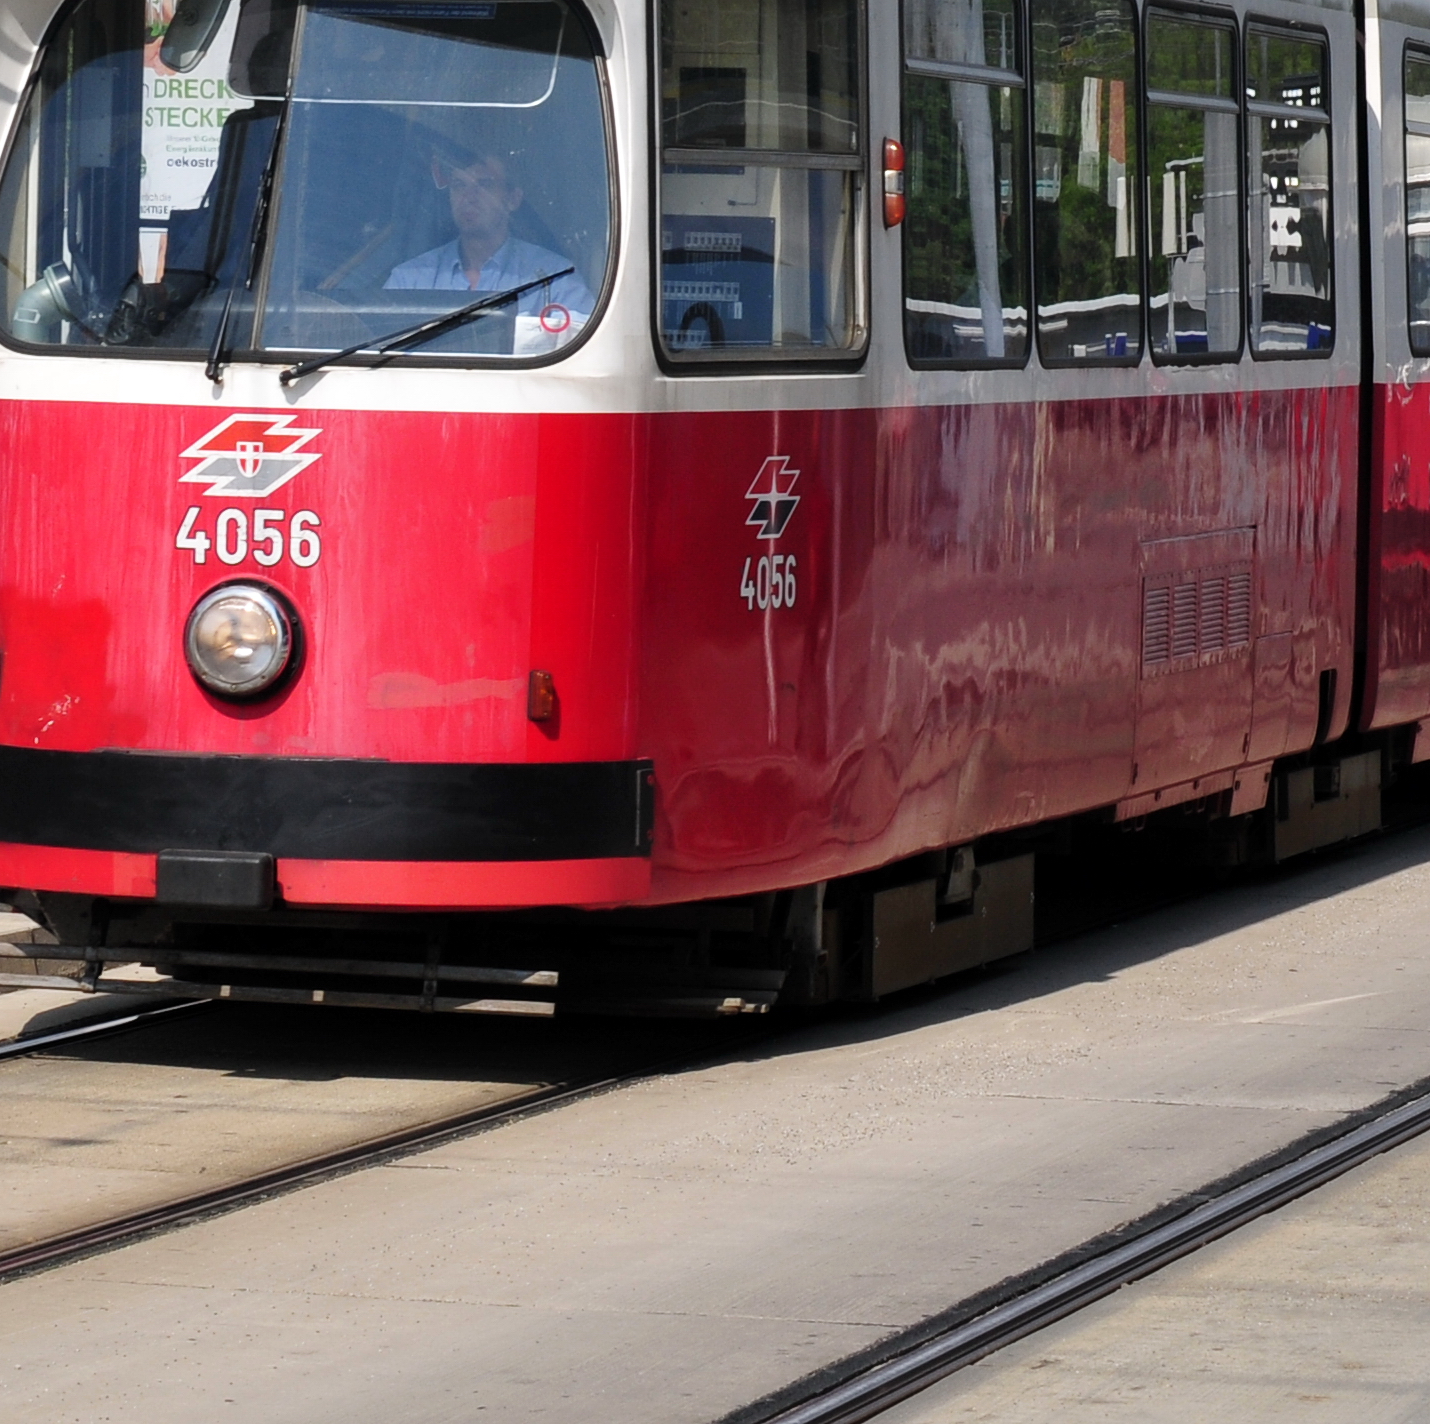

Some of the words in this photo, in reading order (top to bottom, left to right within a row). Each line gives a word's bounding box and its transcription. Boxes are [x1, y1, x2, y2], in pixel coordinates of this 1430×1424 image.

[153, 78, 235, 99] DRECK
[144, 106, 232, 128] STECKE
[166, 156, 217, 168] oekostr
[175, 506, 323, 567] 4056
[739, 554, 797, 611] 4056
